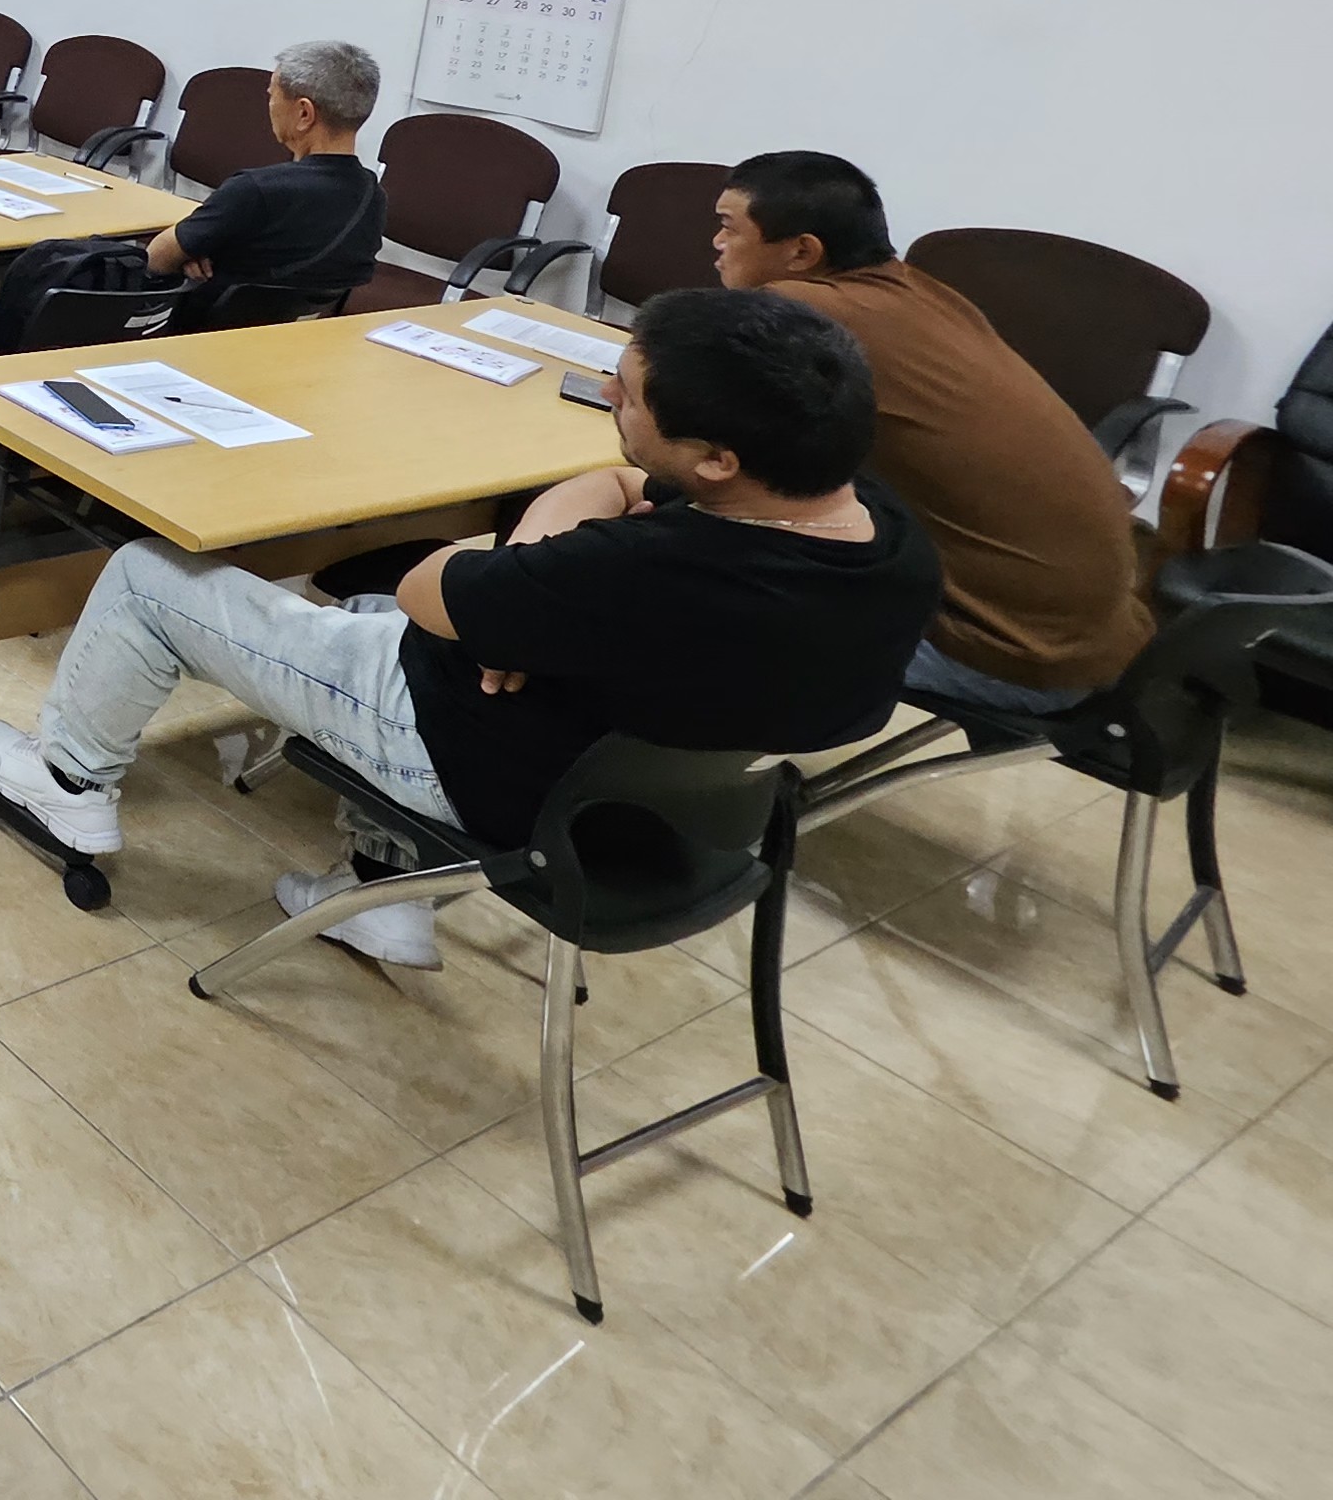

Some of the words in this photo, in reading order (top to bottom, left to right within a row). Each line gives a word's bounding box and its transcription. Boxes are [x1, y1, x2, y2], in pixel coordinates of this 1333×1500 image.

[513, 0, 528, 10] 28
[540, 3, 553, 13] 29
[562, 7, 576, 17] 30
[589, 11, 602, 21] 31
[436, 15, 444, 25] 11
